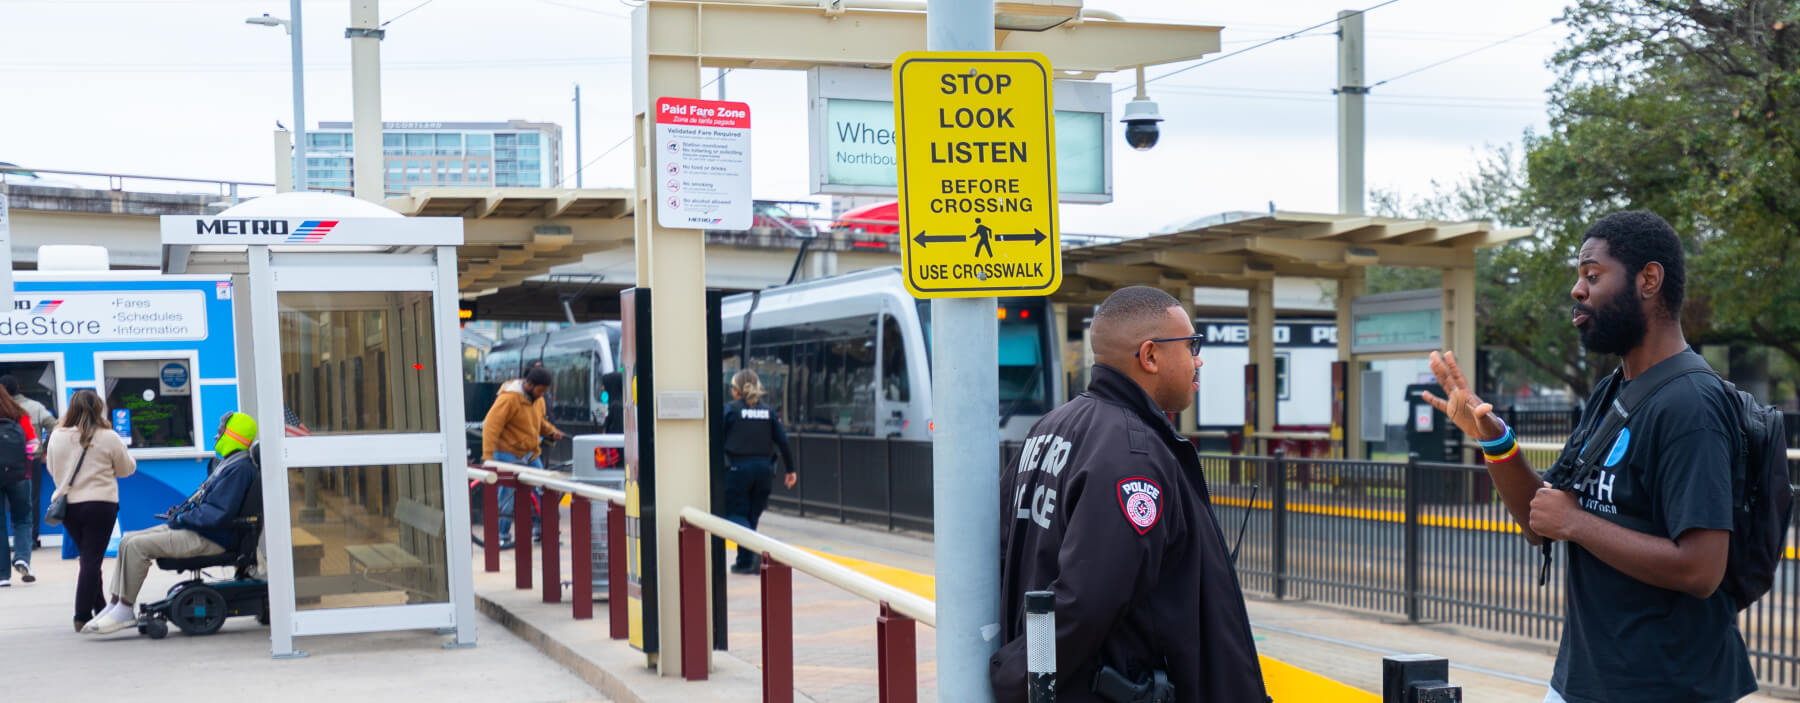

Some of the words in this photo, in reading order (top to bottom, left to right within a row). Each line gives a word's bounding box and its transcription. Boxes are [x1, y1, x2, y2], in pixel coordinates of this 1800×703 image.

[940, 73, 1012, 95] STOP
[662, 103, 686, 114] Paid
[690, 106, 715, 117] Fare
[717, 107, 746, 119] Zone
[939, 107, 1016, 128] LOOK
[668, 127, 696, 135] Validated
[713, 130, 742, 138] Required
[931, 141, 1027, 163] LISTEN
[941, 178, 1020, 194] BEFORE
[930, 198, 1033, 214] CROSSING
[196, 219, 289, 235] METRO
[919, 264, 948, 280] USE
[952, 262, 1044, 280] CROSSWALK
[741, 408, 770, 419] POLICE
[1121, 480, 1160, 500] POLICE
